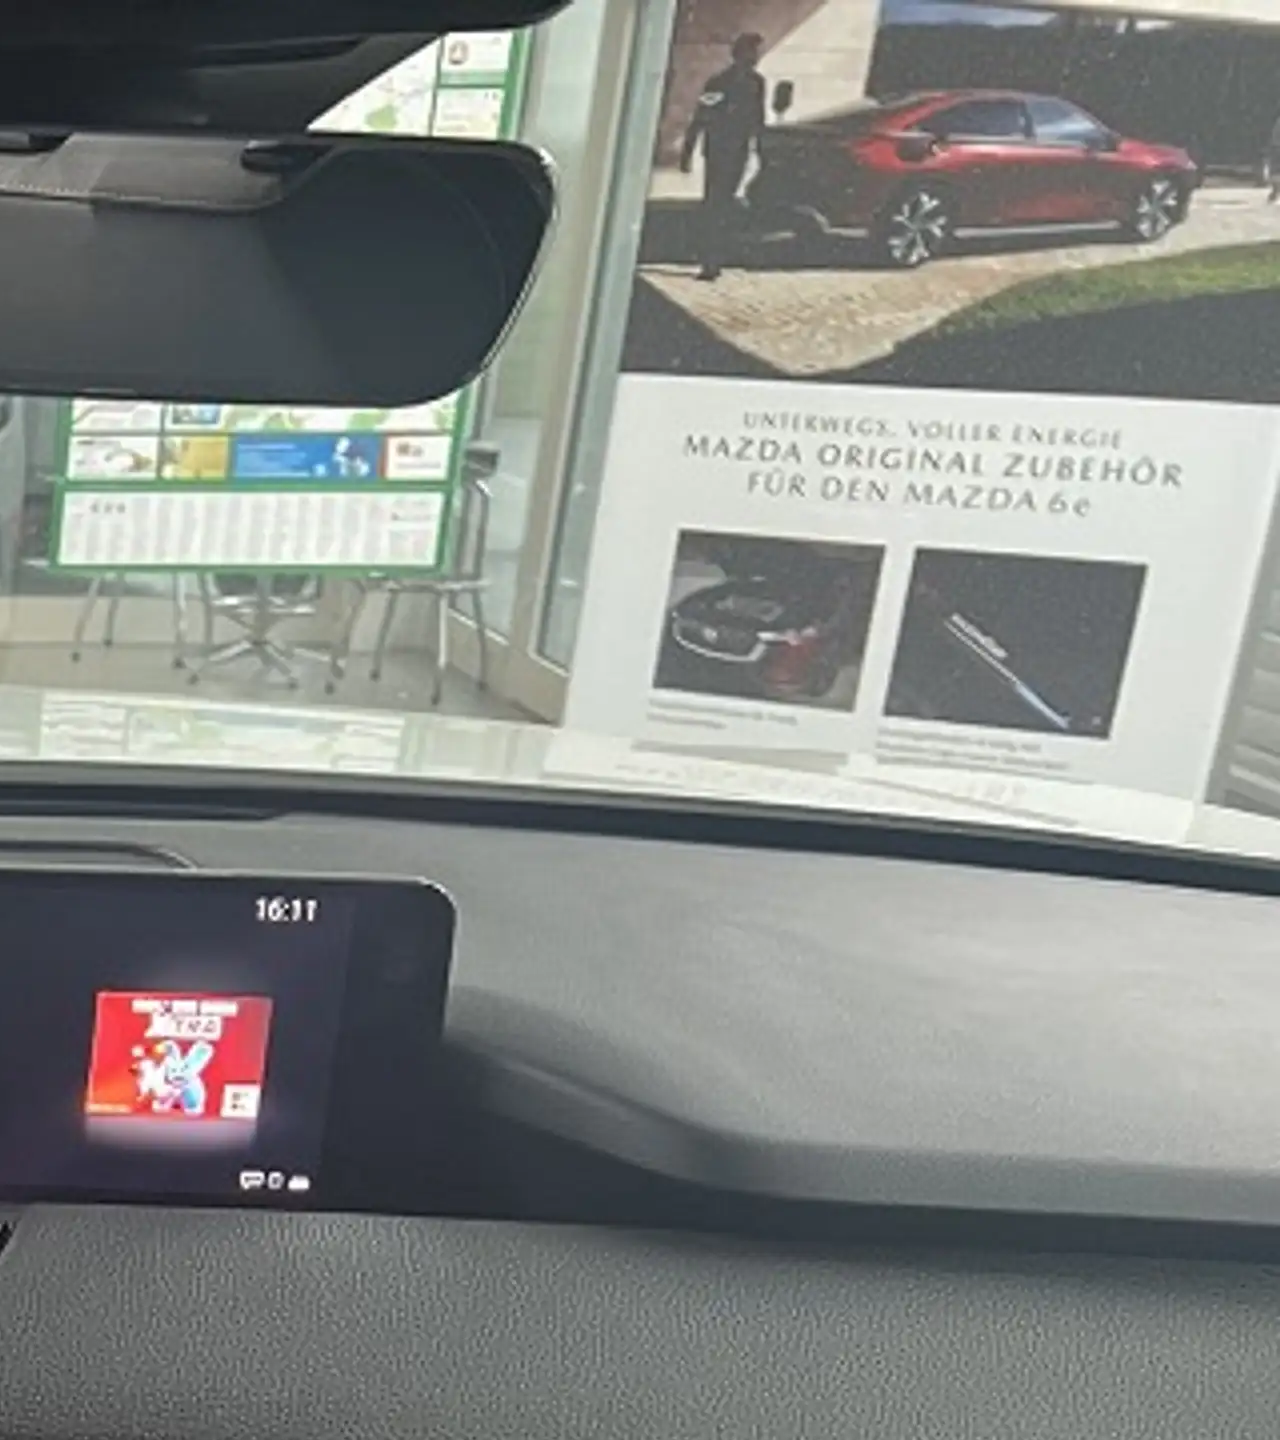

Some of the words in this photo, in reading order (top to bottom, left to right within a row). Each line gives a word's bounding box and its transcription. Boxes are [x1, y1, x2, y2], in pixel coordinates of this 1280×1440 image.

[1011, 422, 1122, 451] ENERGIE
[682, 434, 802, 465] MAZDA
[816, 442, 983, 478] ORIGINAL
[1002, 452, 1183, 488] ZUBEHÖR
[746, 466, 807, 498] FÜR
[820, 475, 890, 502] DEN
[903, 480, 1038, 513] MAZDA
[254, 896, 319, 922] 16:11
